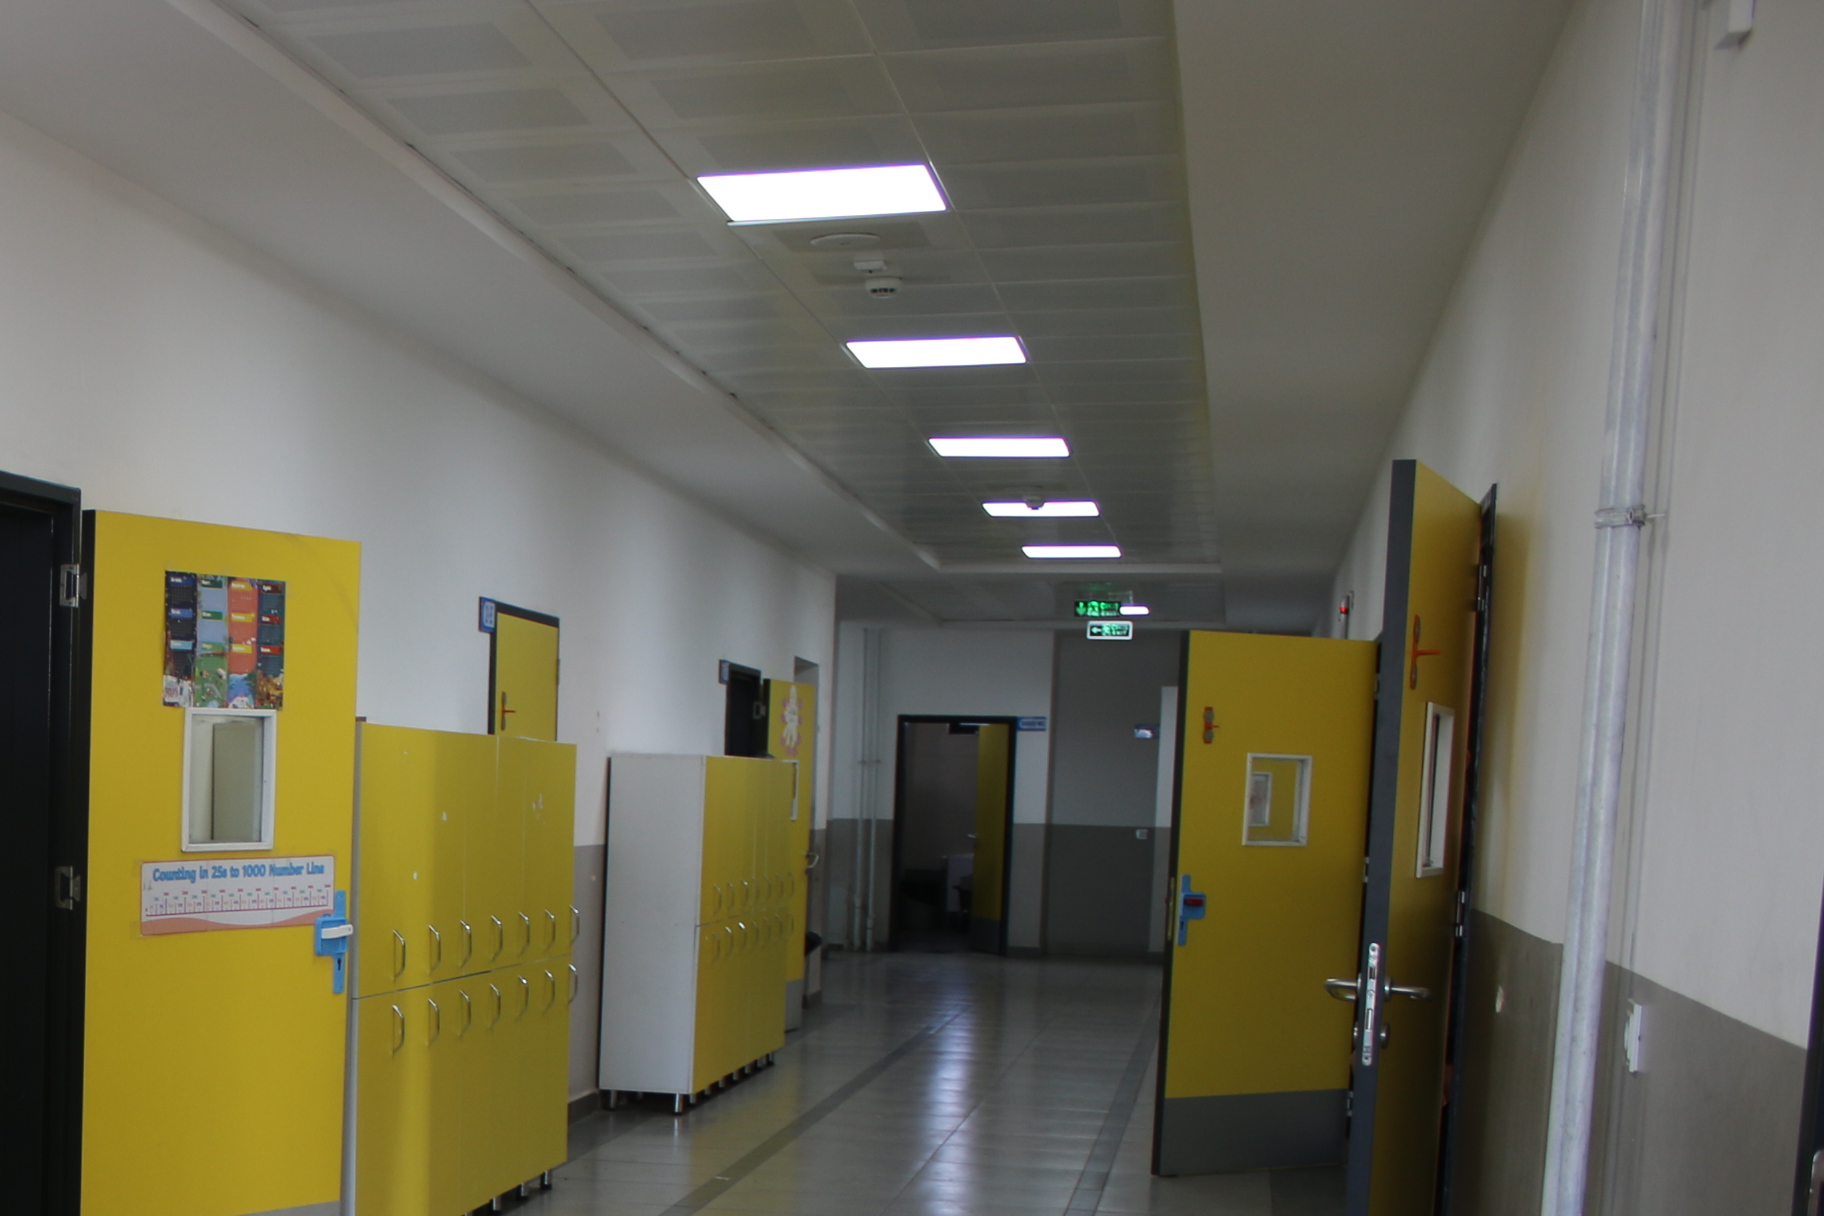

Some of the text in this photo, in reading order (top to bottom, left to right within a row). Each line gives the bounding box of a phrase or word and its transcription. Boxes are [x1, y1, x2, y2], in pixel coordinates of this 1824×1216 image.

[153, 862, 325, 884] Counting in 25s to 1000 Number Line
